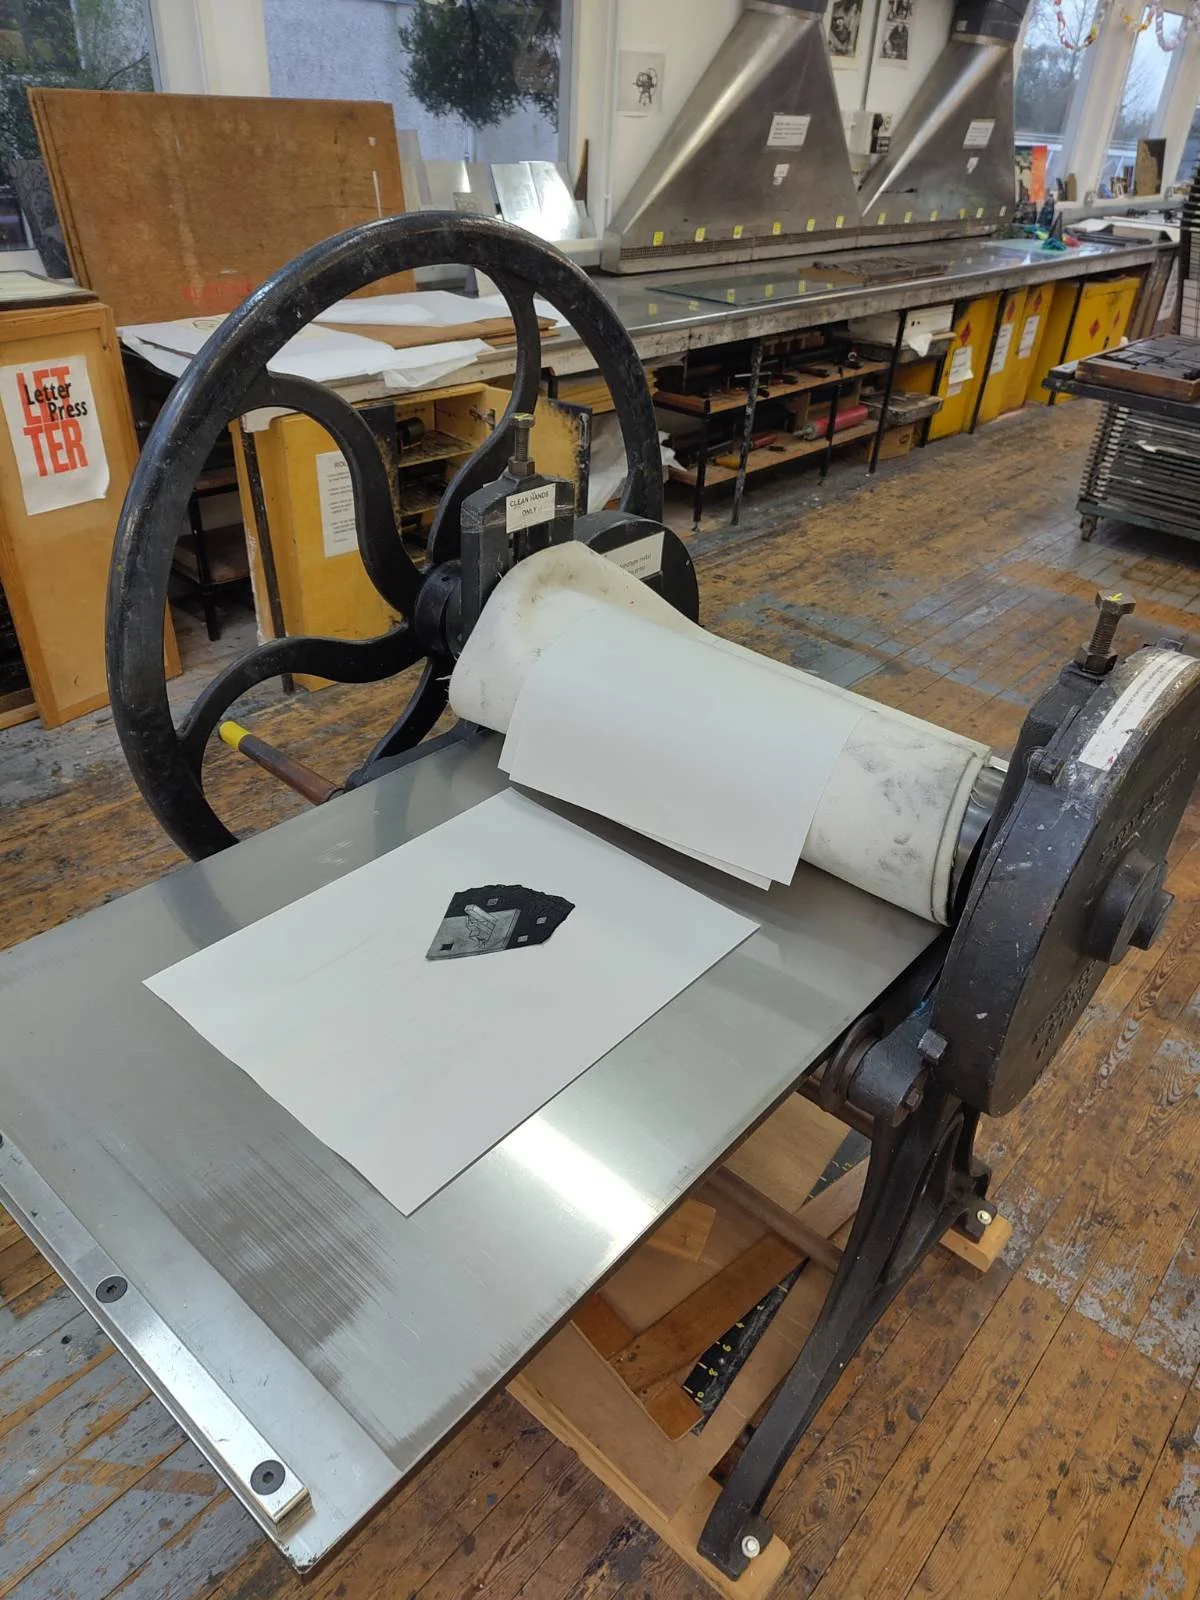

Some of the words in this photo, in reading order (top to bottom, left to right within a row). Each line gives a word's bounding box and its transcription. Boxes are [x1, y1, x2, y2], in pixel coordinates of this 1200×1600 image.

[24, 382, 72, 405] Letter
[48, 401, 88, 422] Press
[23, 419, 88, 477] TER
[510, 497, 529, 507] CLEAN
[530, 490, 549, 501] HANDS
[522, 507, 537, 516] ONLY
[722, 1344, 732, 1352] 6
